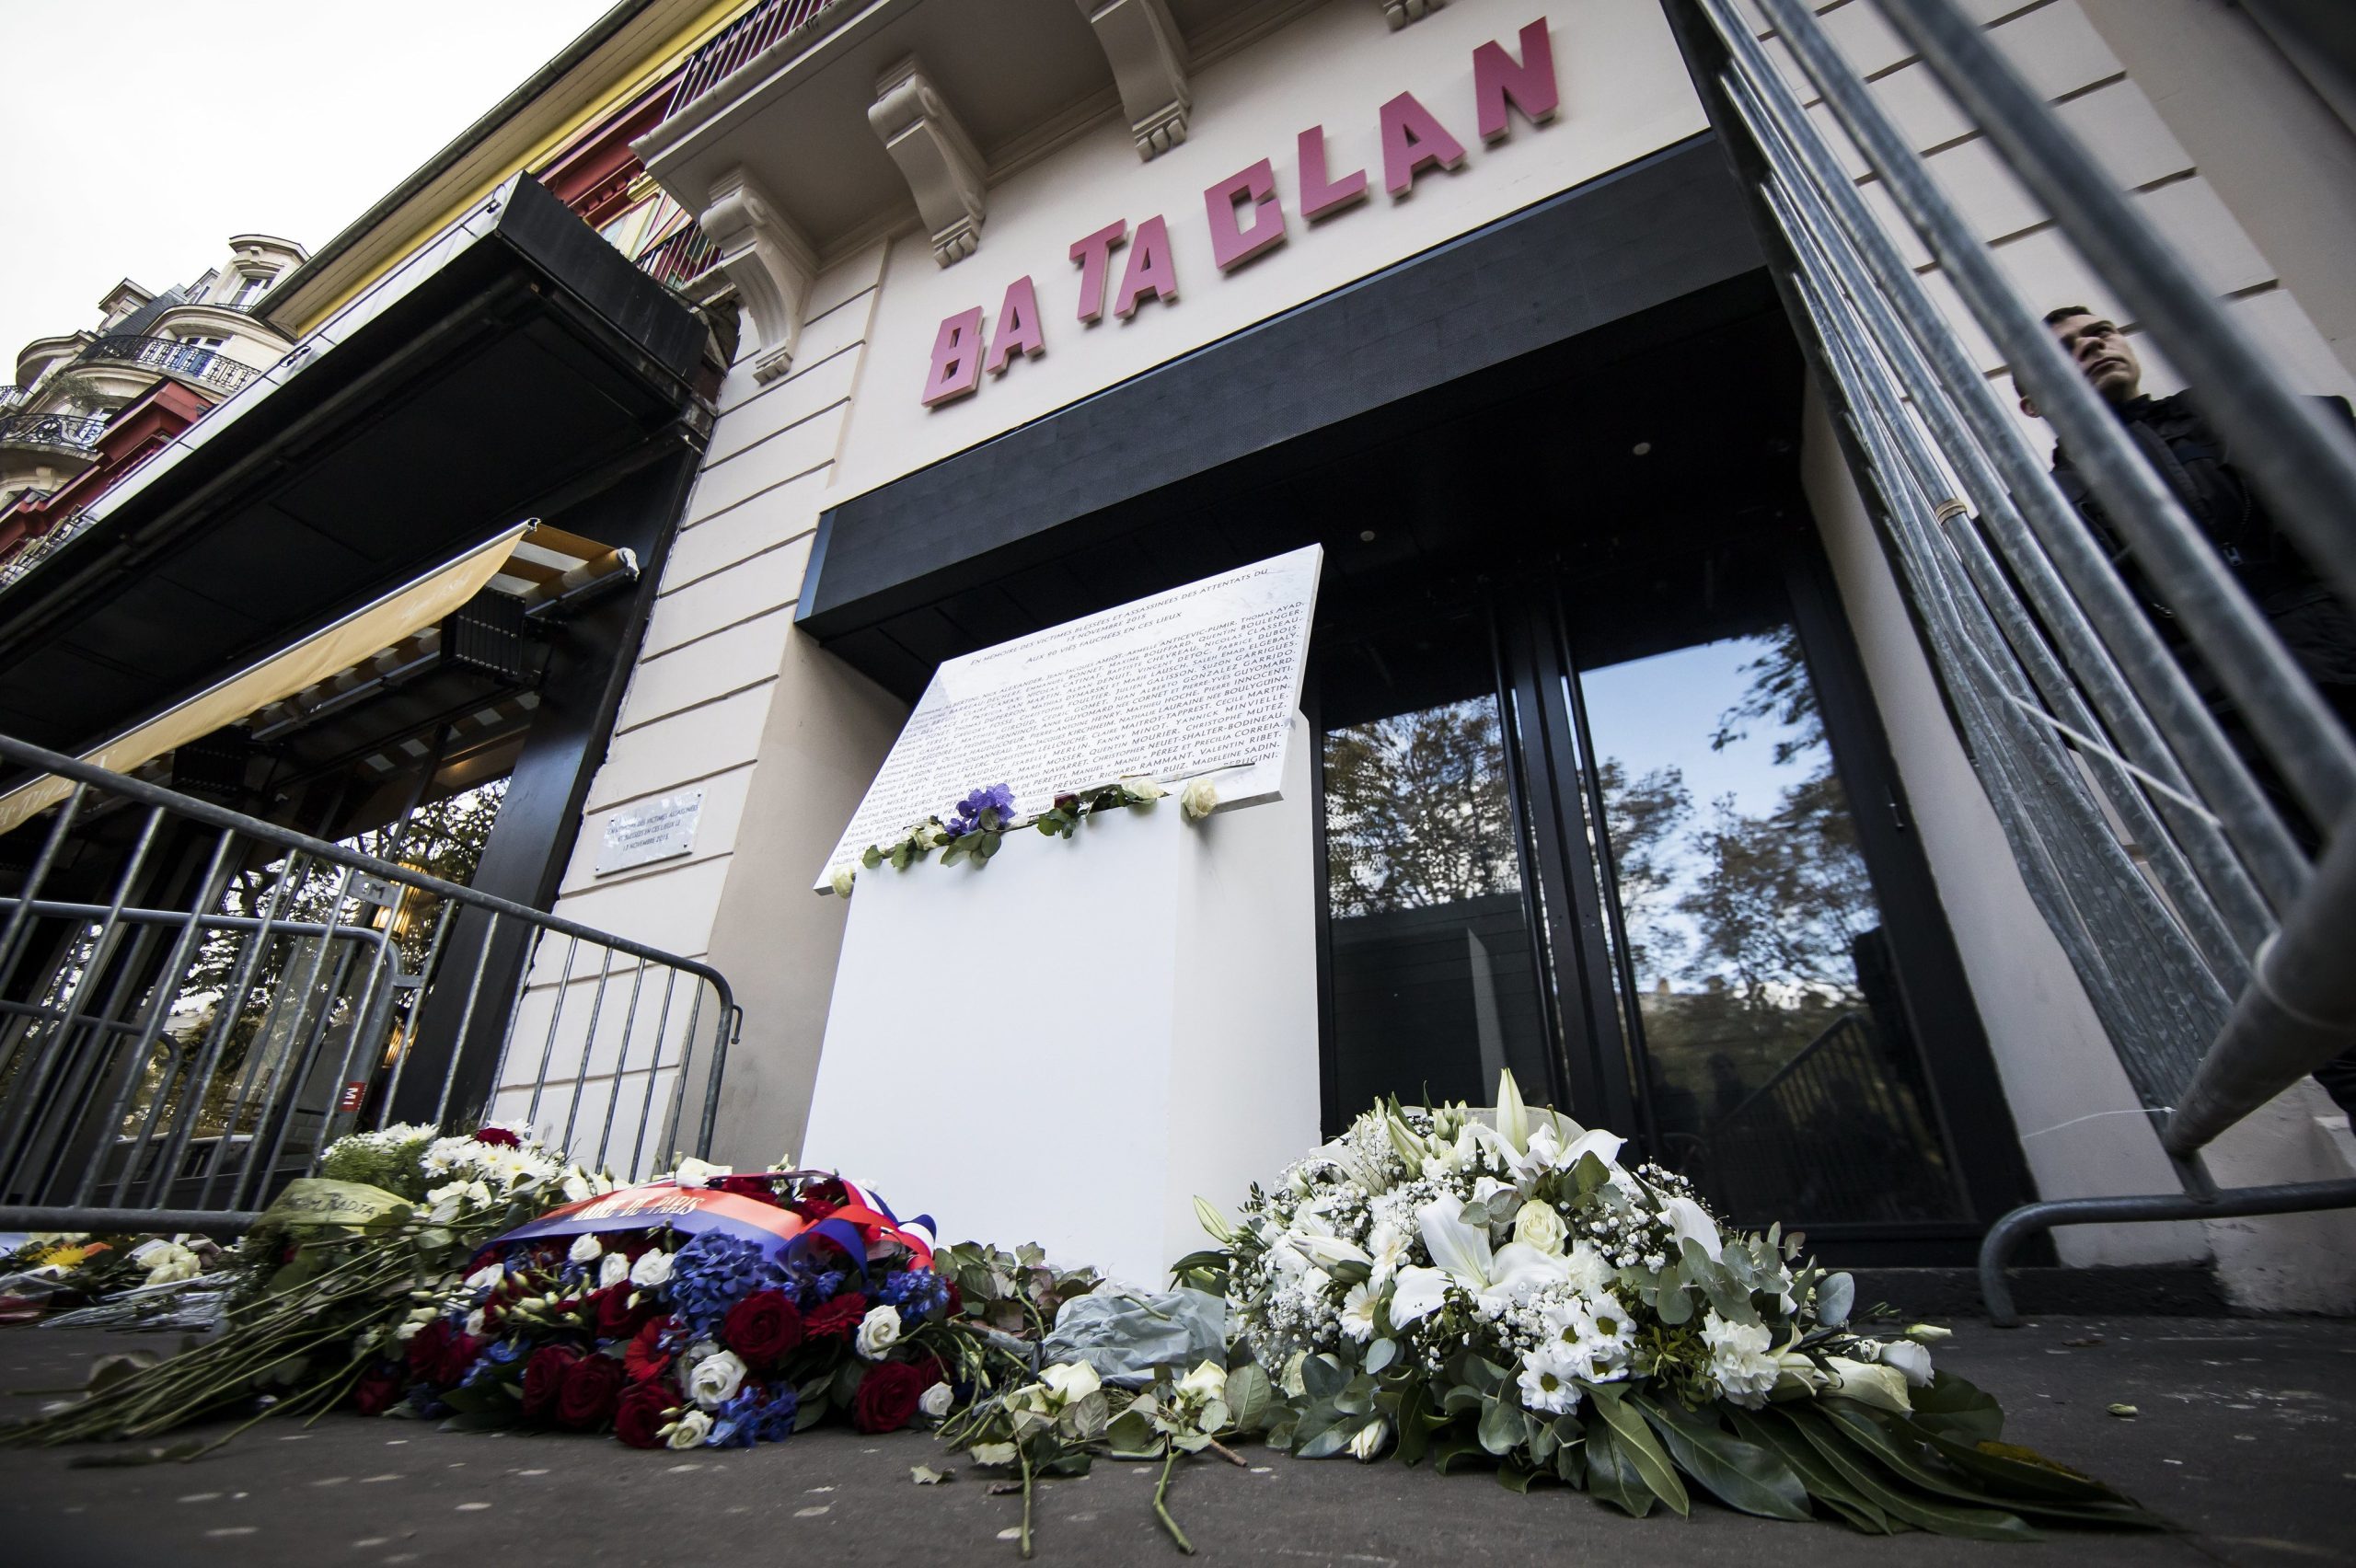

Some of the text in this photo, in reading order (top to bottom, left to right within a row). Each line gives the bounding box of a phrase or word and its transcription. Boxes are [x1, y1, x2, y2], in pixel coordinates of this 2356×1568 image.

[921, 16, 1560, 409] BA TA CLAN
[1200, 573, 1251, 593] ATTENTATS
[1156, 611, 1183, 623] LIEUX
[1183, 663, 1237, 683] GONZALEZ
[1158, 697, 1203, 713] LAURAINE
[1150, 744, 1178, 757] PÉREZ
